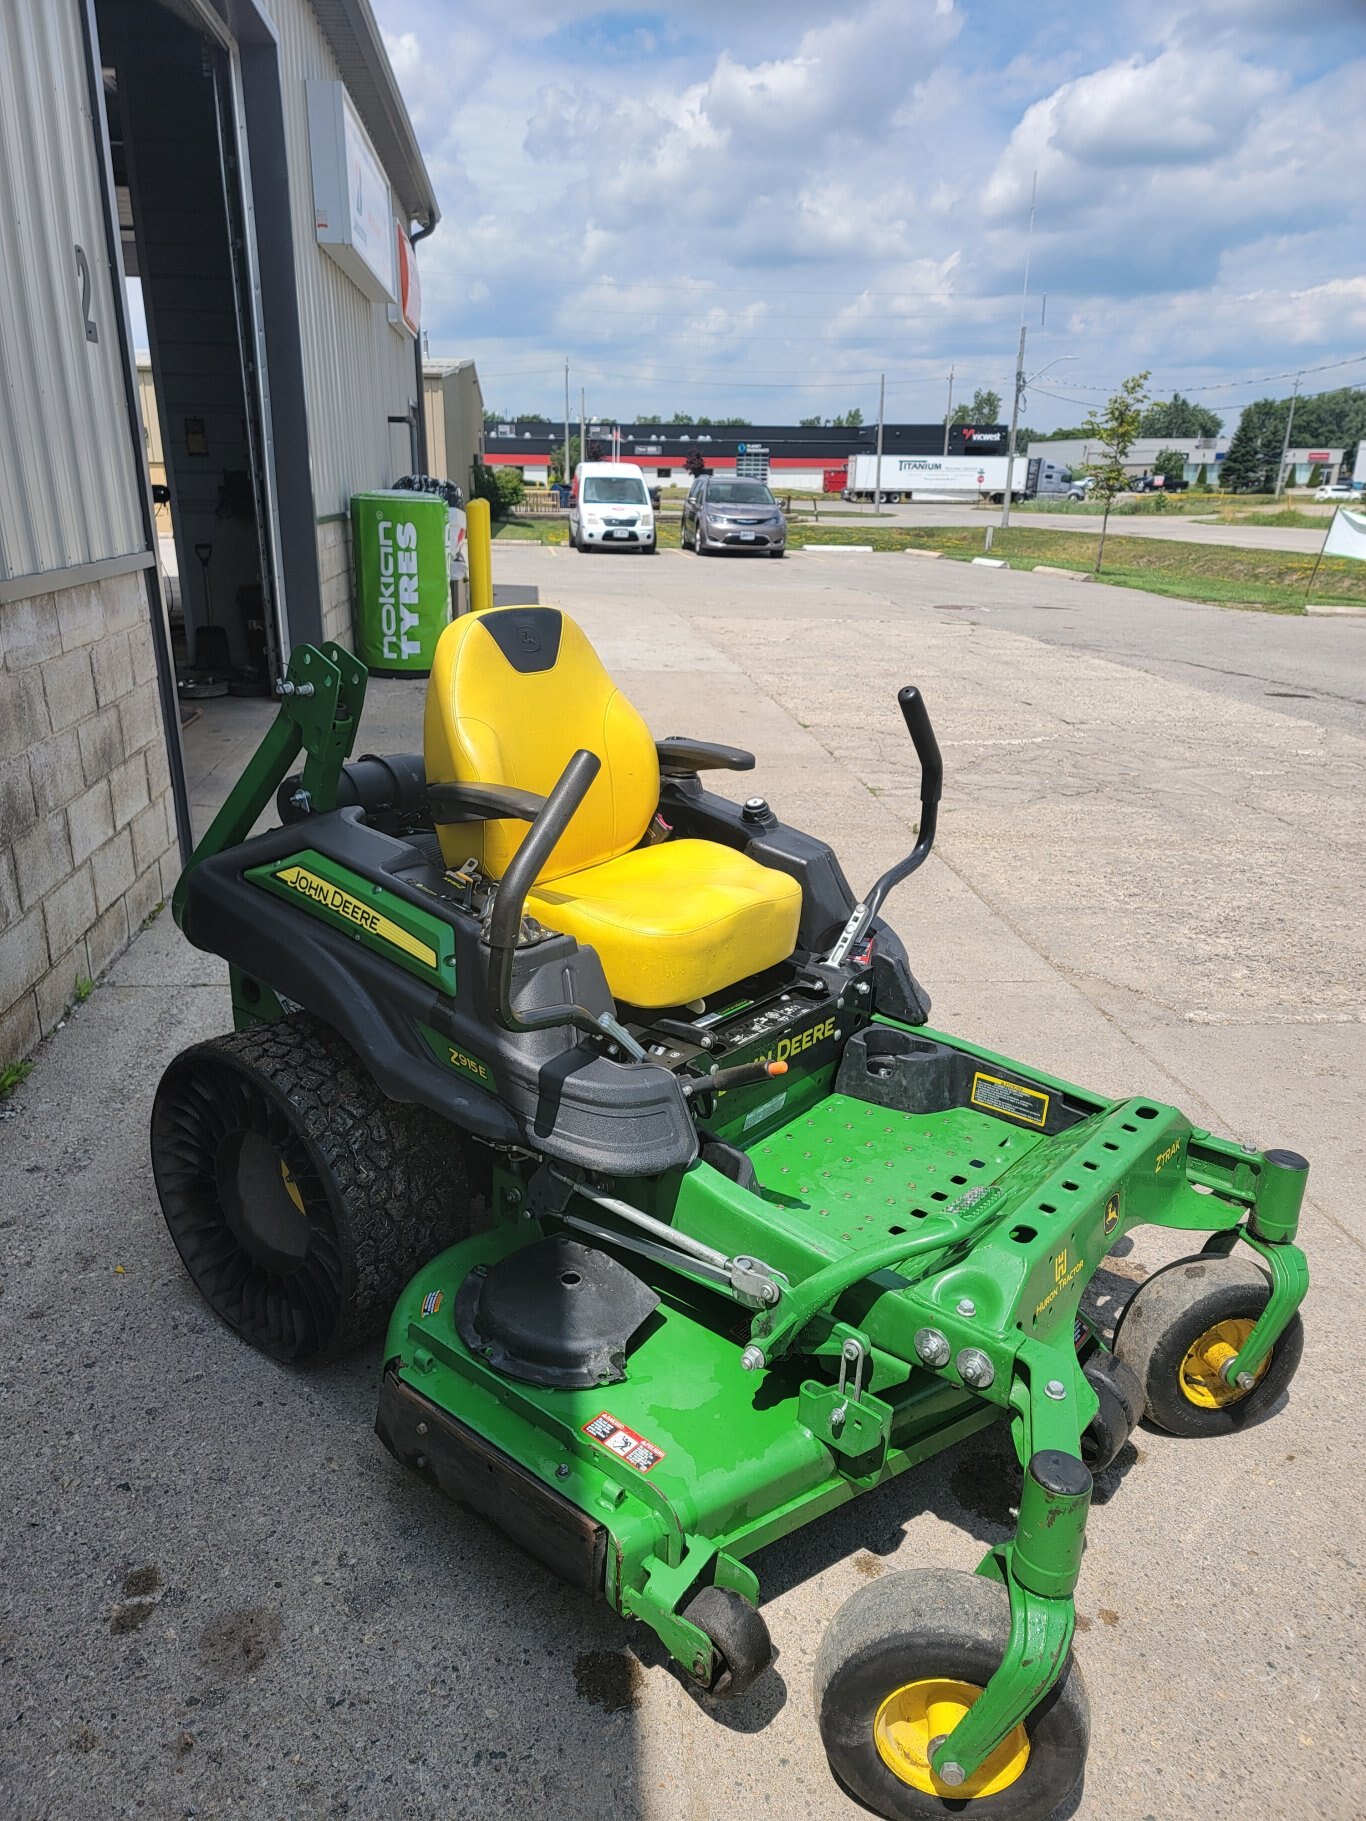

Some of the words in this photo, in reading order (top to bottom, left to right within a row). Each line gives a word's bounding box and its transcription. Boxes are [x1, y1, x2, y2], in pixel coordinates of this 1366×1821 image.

[898, 460, 942, 471] TITANIUM
[396, 521, 421, 660] TYRES
[289, 870, 330, 902] JOHN
[330, 890, 380, 932] DEERE
[448, 1047, 488, 1080] Z915E
[776, 1016, 836, 1062] DEERE
[1036, 1286, 1059, 1316] HURON
[1058, 1259, 1084, 1291] TRACTOR
